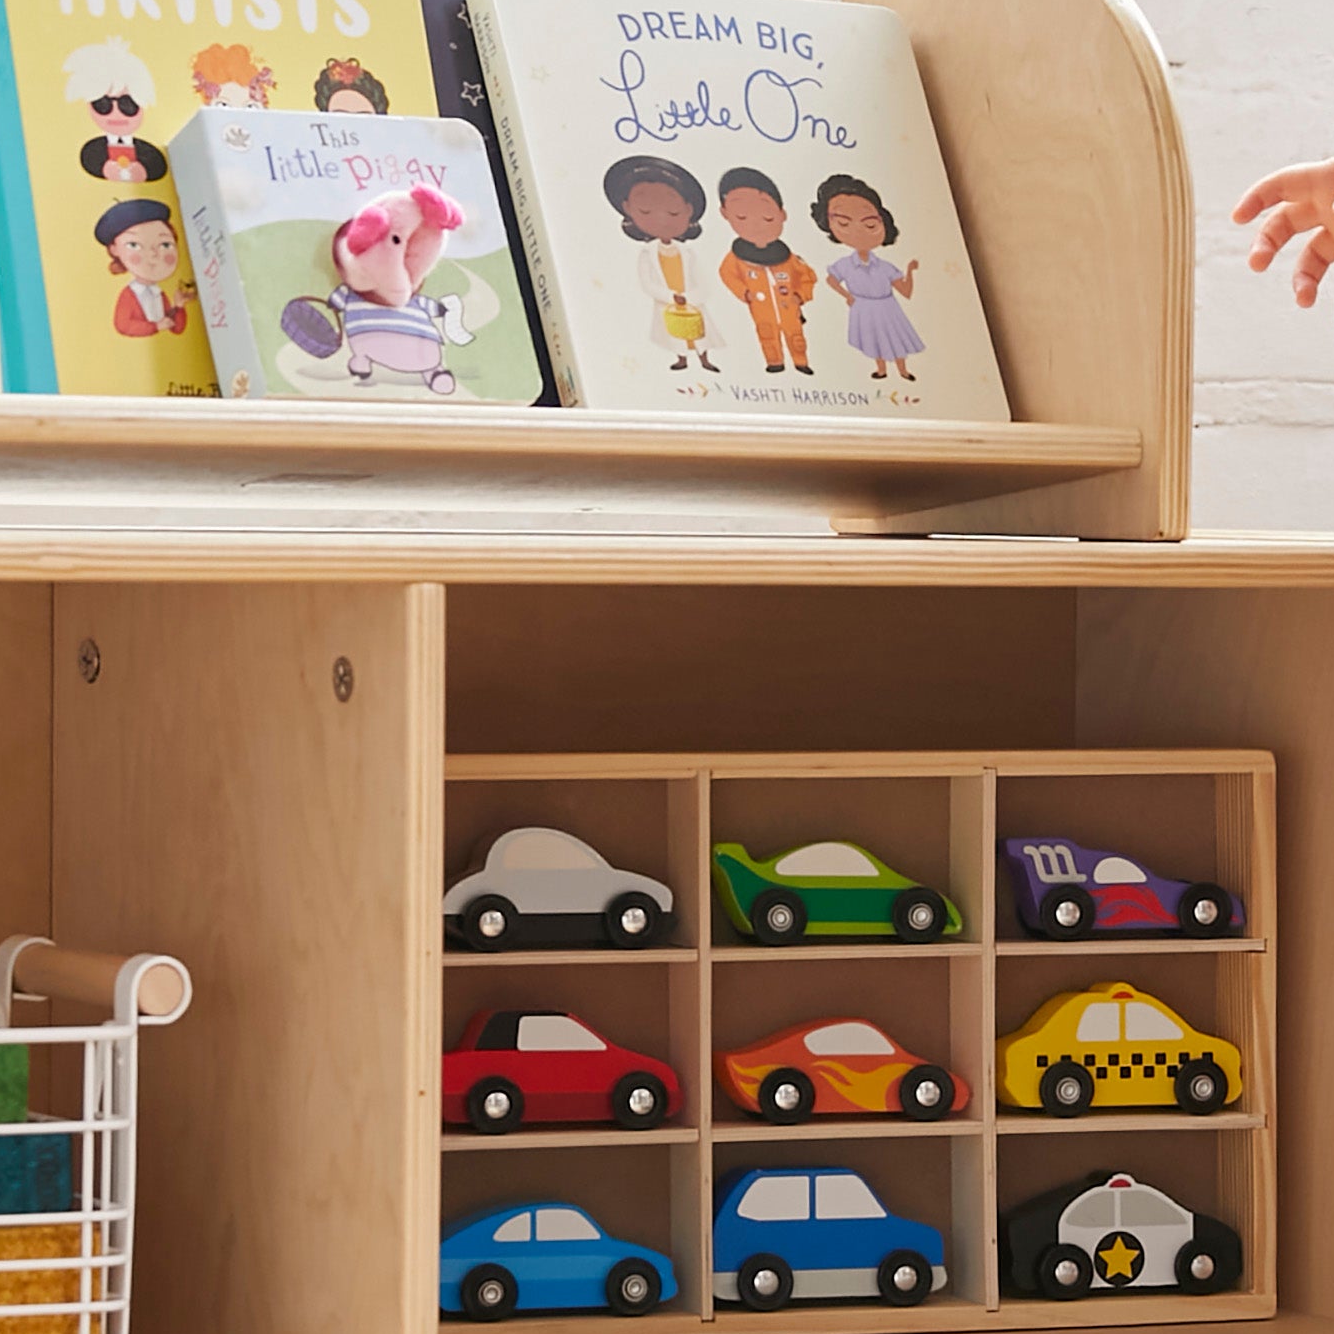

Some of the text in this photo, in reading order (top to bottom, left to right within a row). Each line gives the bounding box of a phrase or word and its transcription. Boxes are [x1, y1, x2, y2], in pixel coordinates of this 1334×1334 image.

[617, 11, 824, 70] DREAM BIG,
[600, 50, 857, 149] Little One
[310, 123, 360, 149] This
[265, 146, 447, 190] little piggy
[500, 117, 520, 174] DREAM
[523, 216, 543, 269] LITTLE
[537, 275, 553, 314] ONE
[730, 384, 869, 406] VASHTI HARRISON
